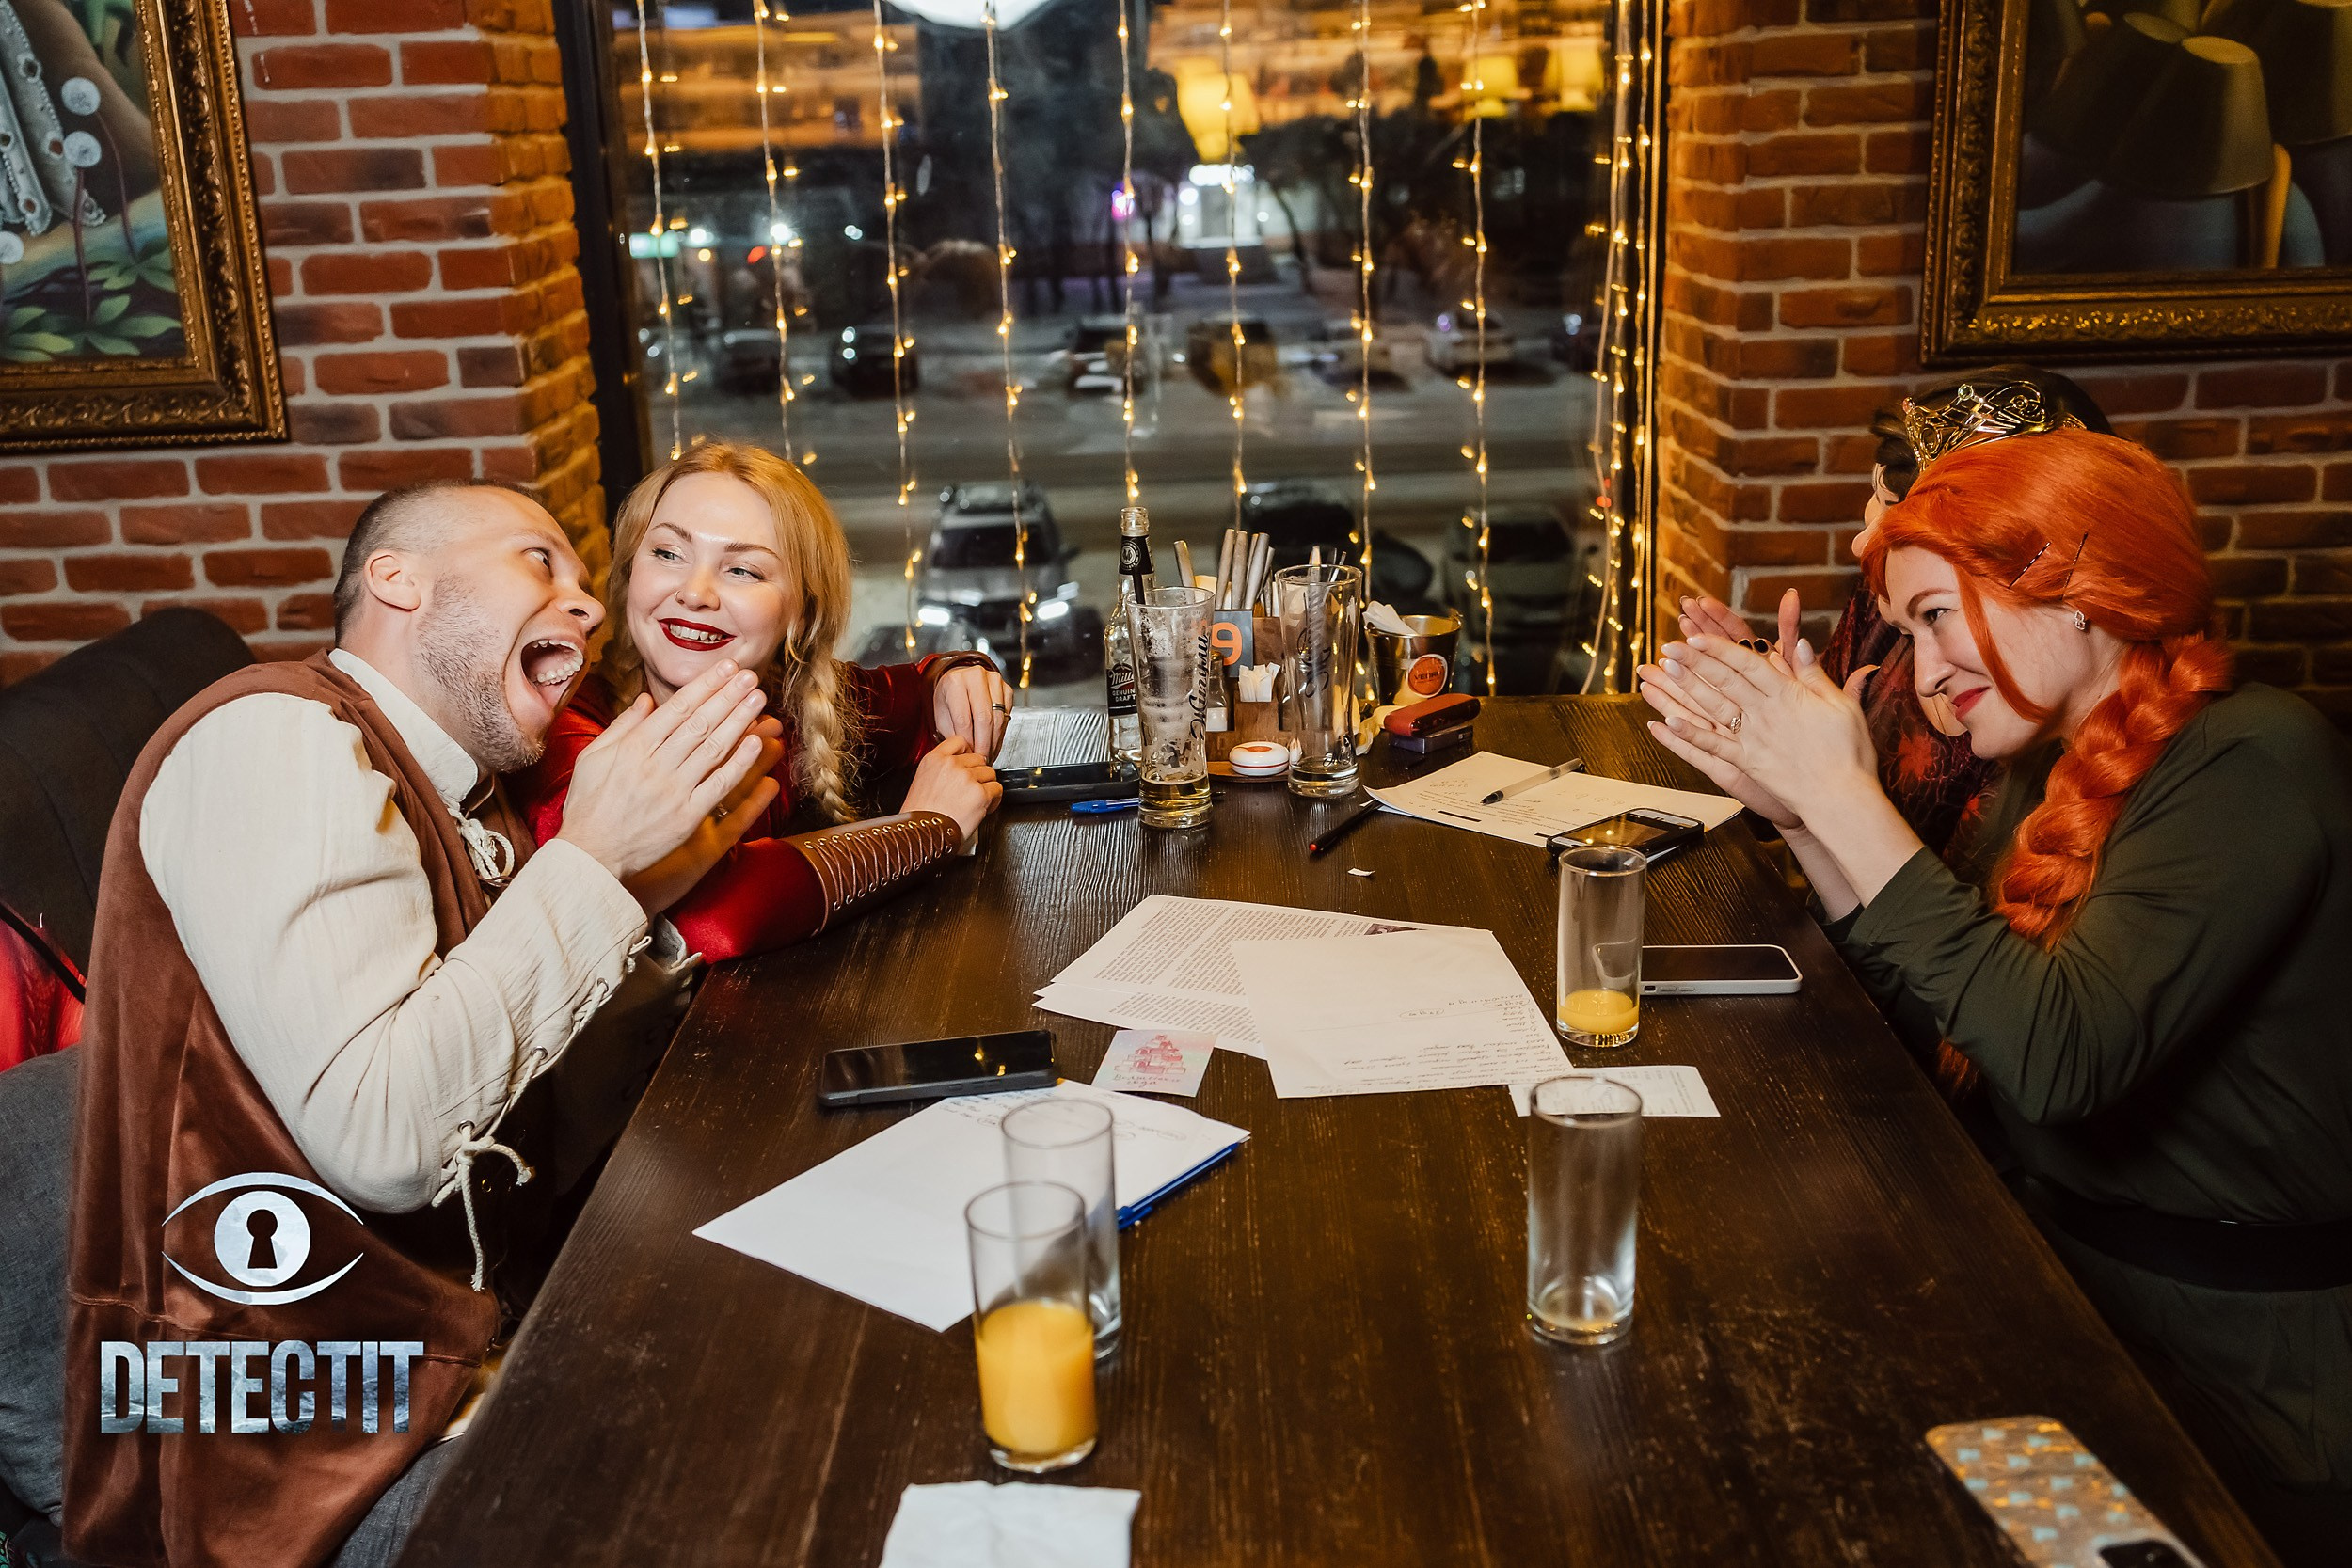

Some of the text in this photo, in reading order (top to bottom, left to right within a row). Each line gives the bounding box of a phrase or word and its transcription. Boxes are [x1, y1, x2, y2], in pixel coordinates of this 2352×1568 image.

[1210, 622, 1243, 666] 9
[1108, 669, 1135, 686] Mill
[1112, 688, 1136, 696] GENUIN
[1115, 694, 1136, 703] DRAFT
